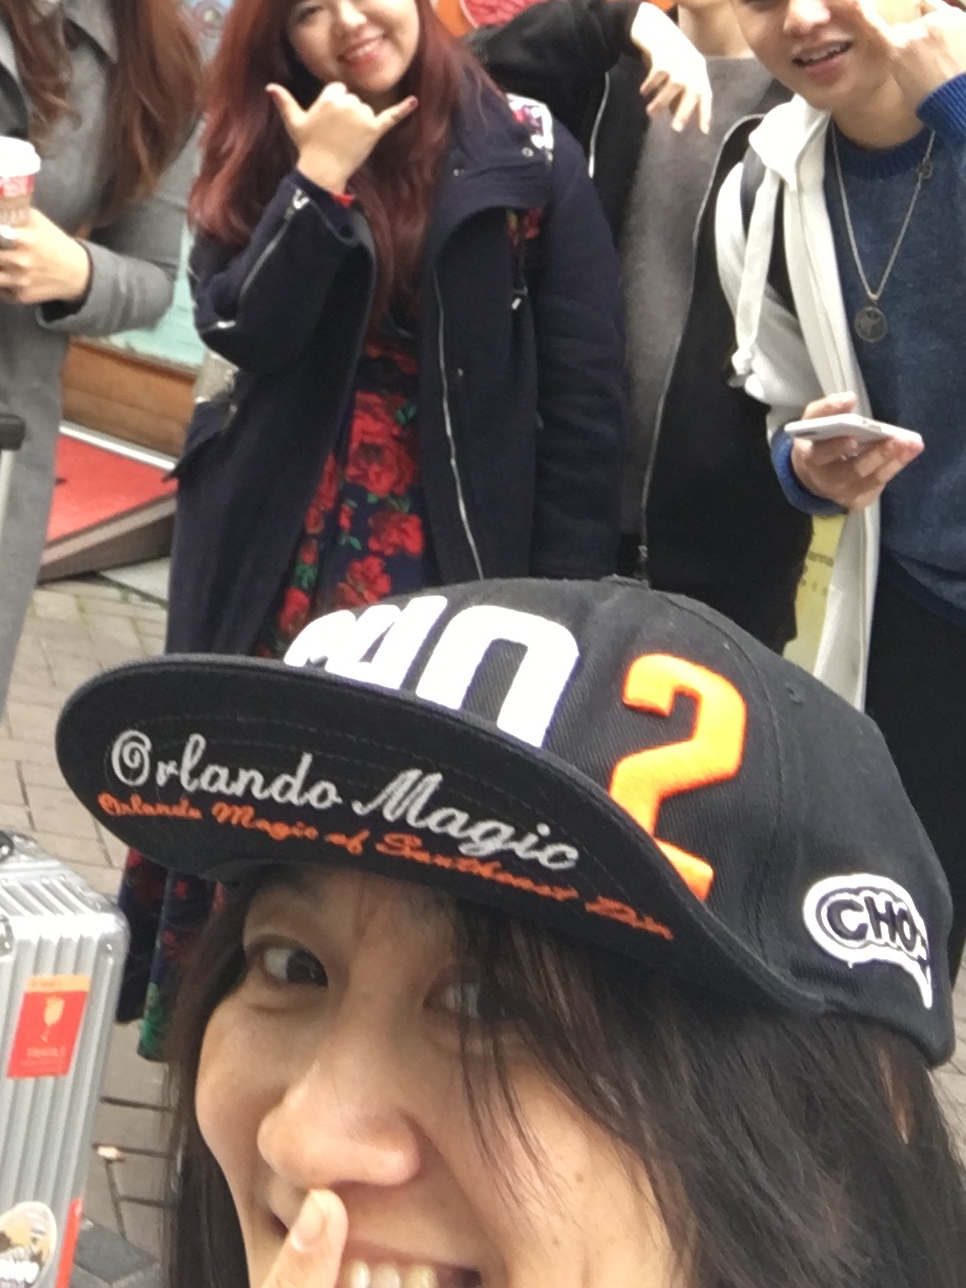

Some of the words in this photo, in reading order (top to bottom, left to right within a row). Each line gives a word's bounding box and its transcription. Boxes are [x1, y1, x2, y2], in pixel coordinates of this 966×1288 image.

[111, 729, 343, 810] Orlando
[351, 768, 580, 870] Magic
[211, 801, 319, 841] Magic
